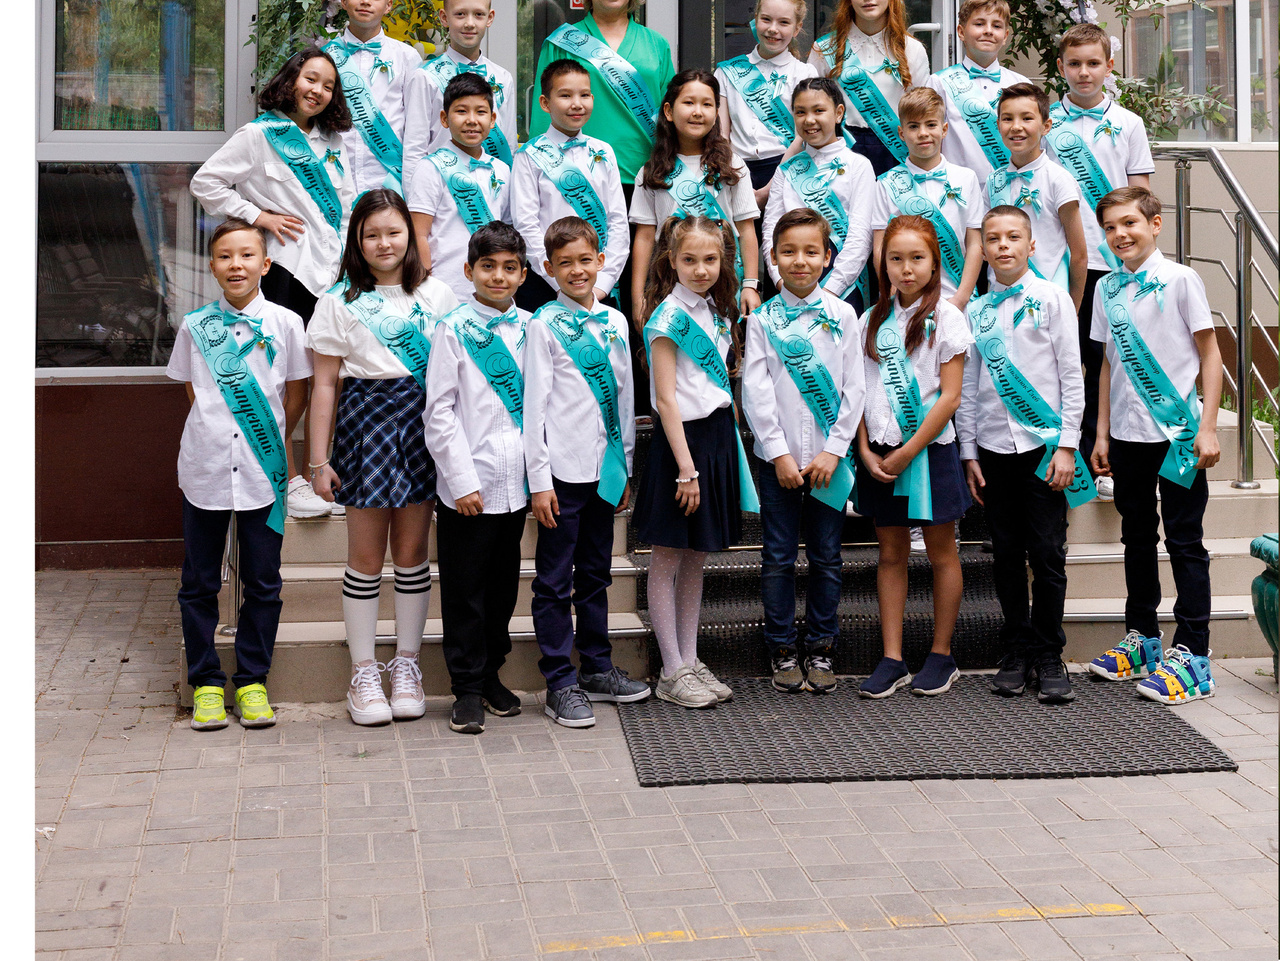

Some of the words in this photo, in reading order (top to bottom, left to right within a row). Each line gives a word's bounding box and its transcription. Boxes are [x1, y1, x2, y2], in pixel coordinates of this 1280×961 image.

[339, 71, 390, 158] Выпускник
[842, 68, 904, 150] Выпускница
[1111, 305, 1165, 405] Выпускник
[214, 352, 280, 456] Выпускник
